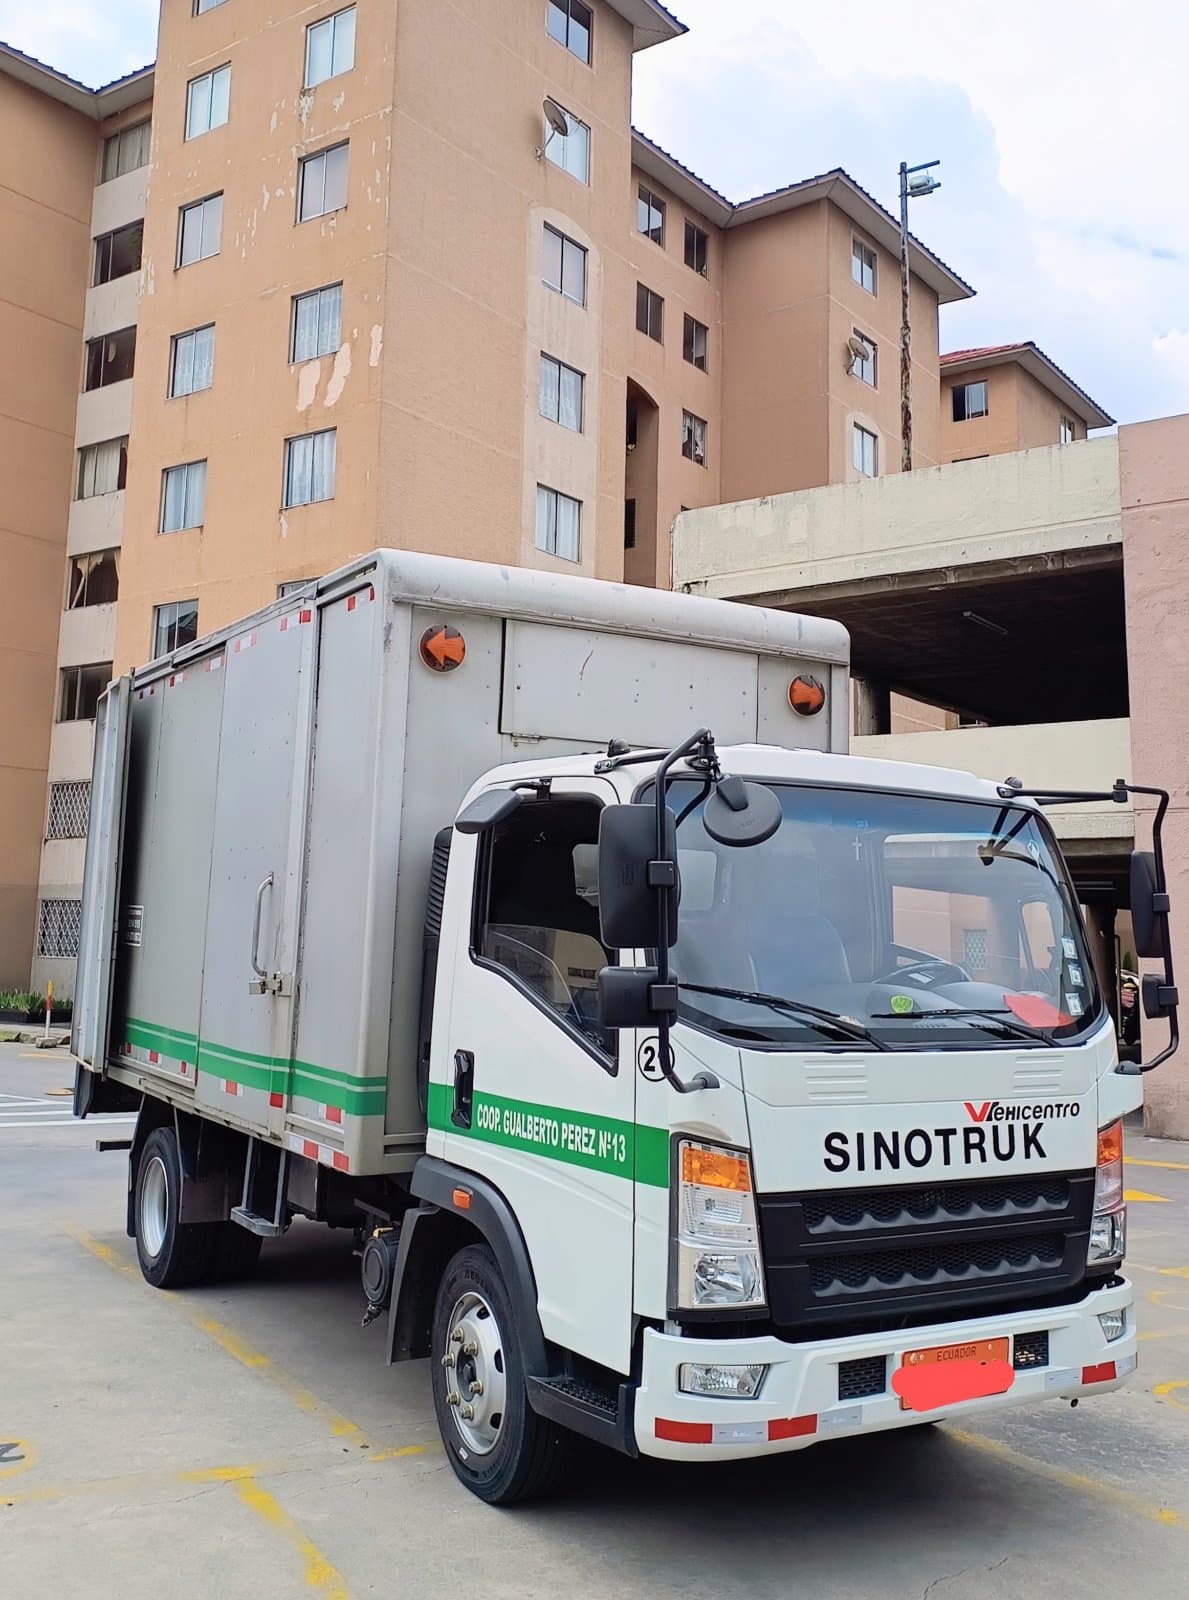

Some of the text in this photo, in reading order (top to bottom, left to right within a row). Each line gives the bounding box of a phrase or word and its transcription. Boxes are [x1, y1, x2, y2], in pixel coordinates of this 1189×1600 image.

[477, 1103, 501, 1132] COOP.
[503, 1110, 559, 1146] GUALBERTO
[561, 1122, 596, 1156] PEREZ
[823, 1122, 1047, 1172] SINOTRUK
[936, 1345, 977, 1362] ECUADOR
